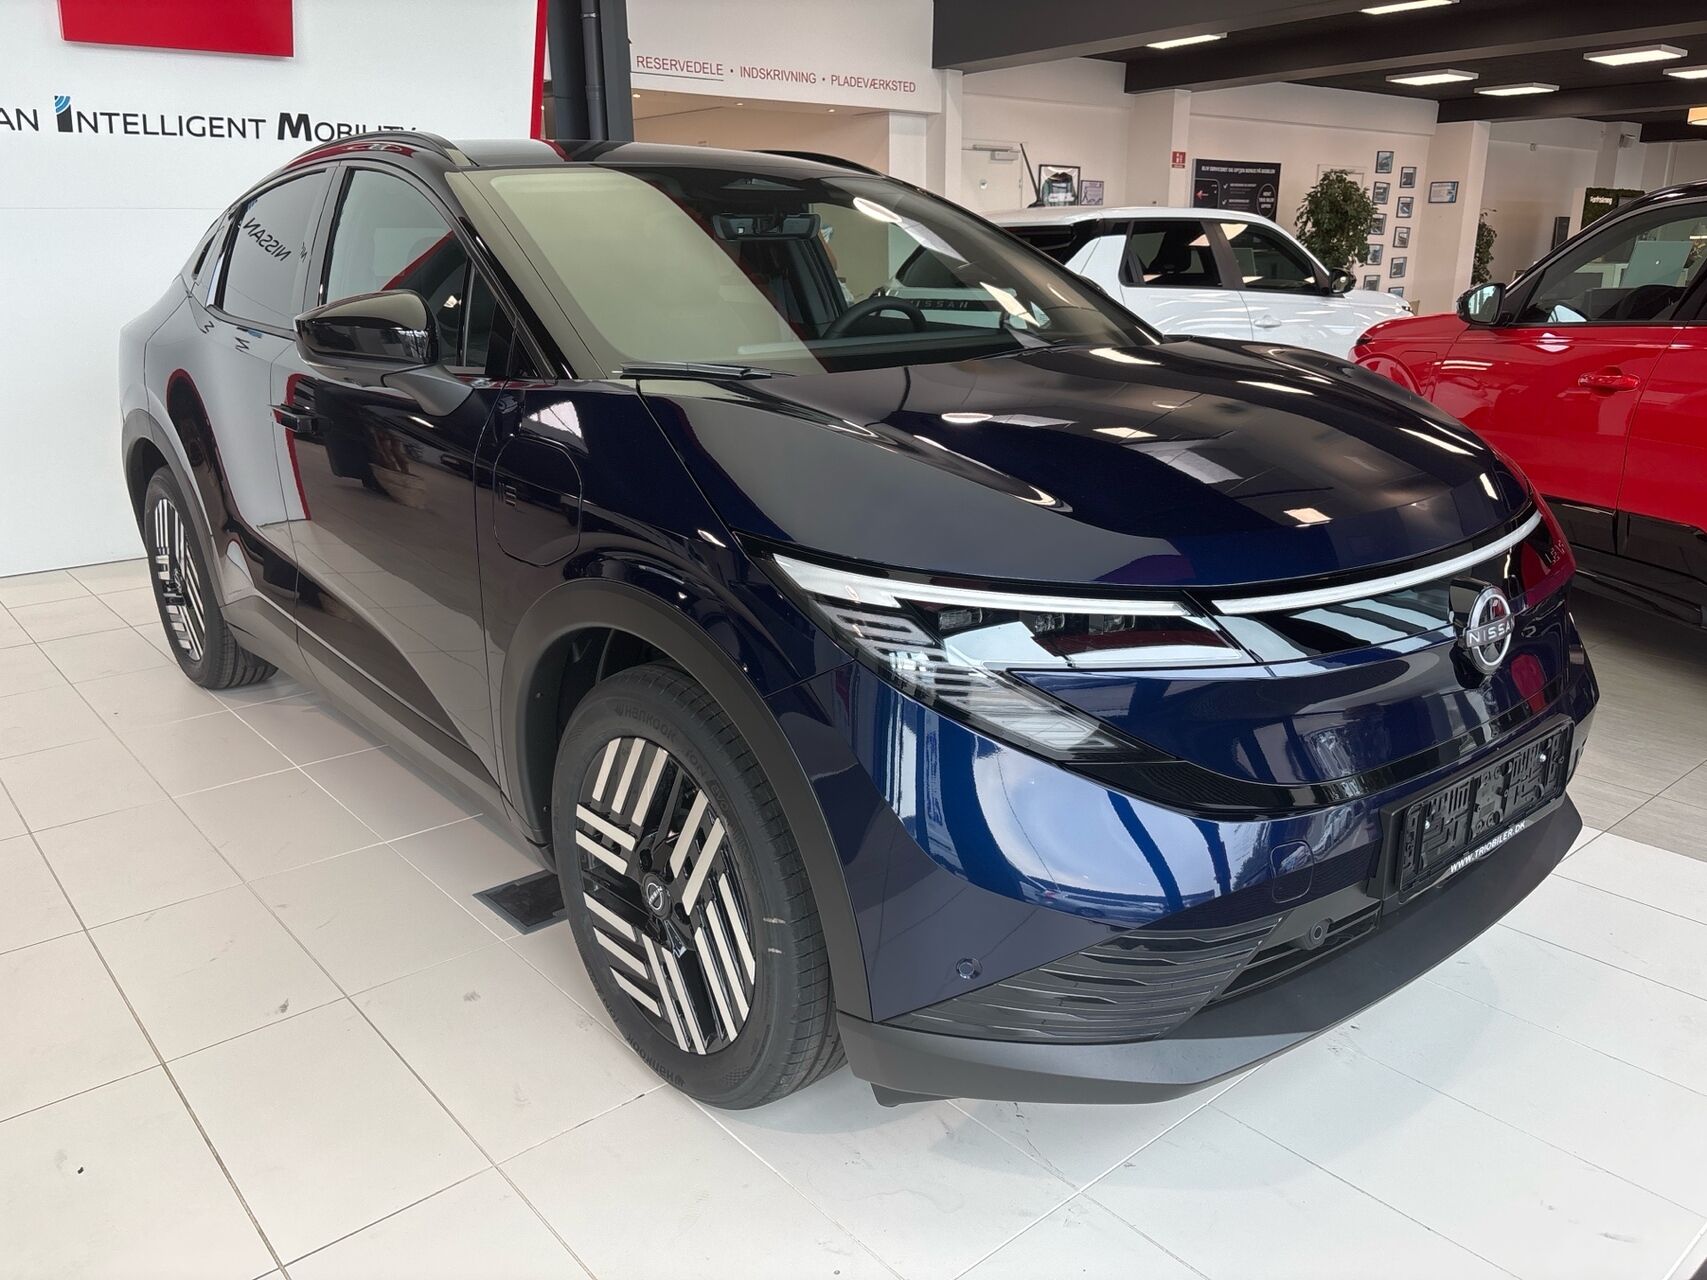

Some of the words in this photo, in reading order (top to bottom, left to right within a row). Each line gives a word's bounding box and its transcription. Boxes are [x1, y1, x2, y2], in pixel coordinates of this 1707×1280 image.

[636, 55, 724, 76] RESERVEDELE
[740, 66, 817, 84] INDSKRIVNING
[831, 74, 916, 93] PLADEVÆRKSTED
[54, 95, 266, 140] INTELLIGENT
[911, 300, 969, 309] ISSAN
[1469, 617, 1515, 645] NISSA
[1450, 820, 1526, 873] WWW.TRIOBILER.DK
